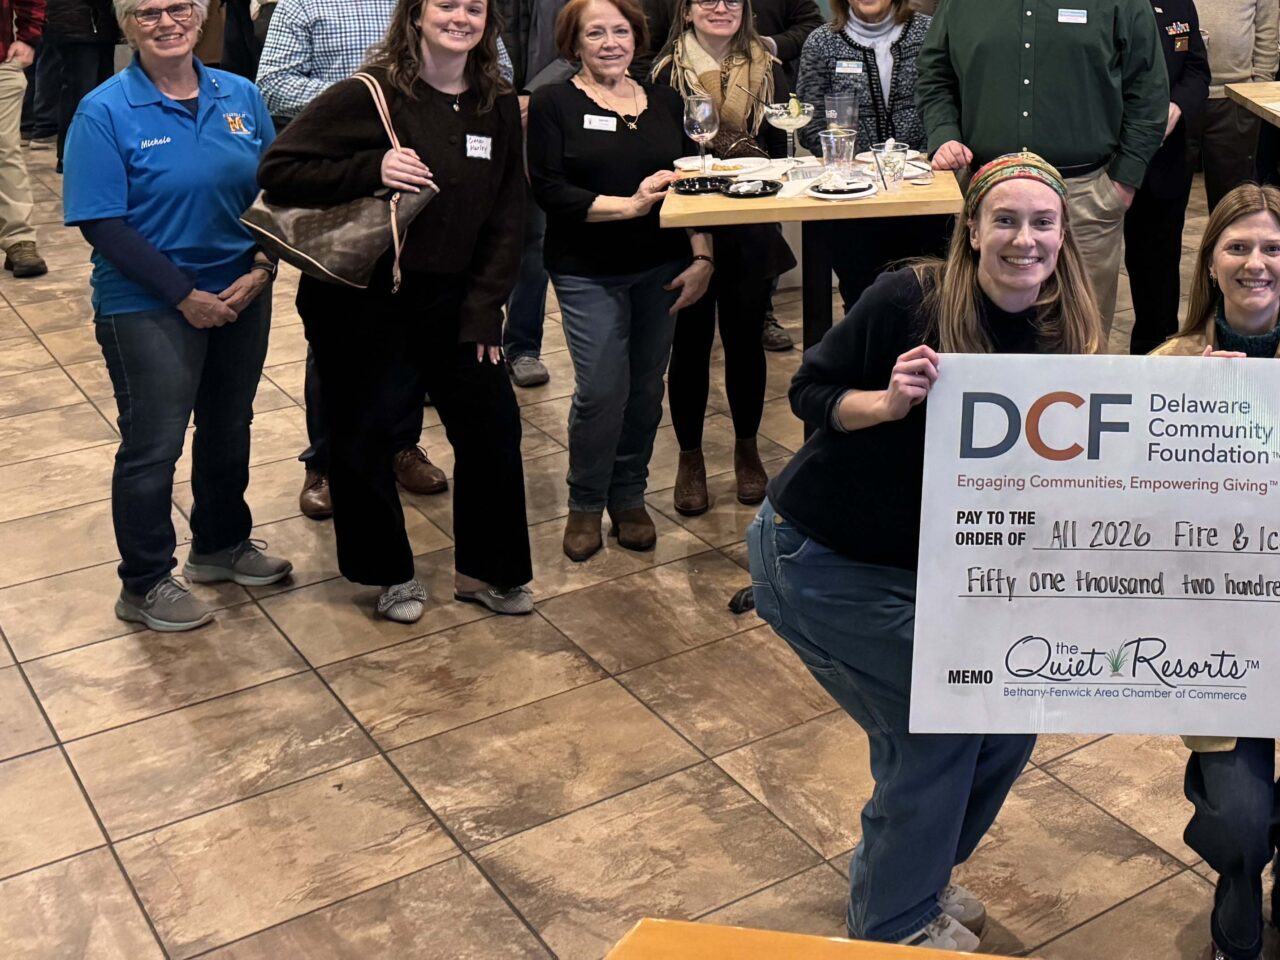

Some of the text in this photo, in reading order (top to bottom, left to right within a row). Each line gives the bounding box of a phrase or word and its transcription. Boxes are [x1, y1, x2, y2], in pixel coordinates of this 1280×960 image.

[1150, 394, 1250, 414] Delaware
[959, 391, 1132, 461] DCF
[1149, 418, 1273, 444] Community
[957, 474, 1025, 490] Engaging
[1030, 475, 1126, 490] Communities,
[1130, 476, 1219, 494] Empowering
[956, 511, 1035, 525] PAY TO THE
[956, 531, 1026, 546] ORDER OF
[1051, 520, 1077, 549] All
[1089, 520, 1151, 548] 2026
[1175, 521, 1219, 548] Fire
[1232, 523, 1249, 551] &
[967, 566, 1017, 601] Fifty
[1029, 570, 1065, 592] one
[1076, 570, 1164, 595] thousand
[1182, 574, 1215, 596] two
[1005, 635, 1106, 681] Quiet
[1055, 642, 1078, 654] the
[948, 670, 993, 684] MEMO
[1003, 687, 1247, 701] Bethany-Fenwick Area Chamber of Commerce
